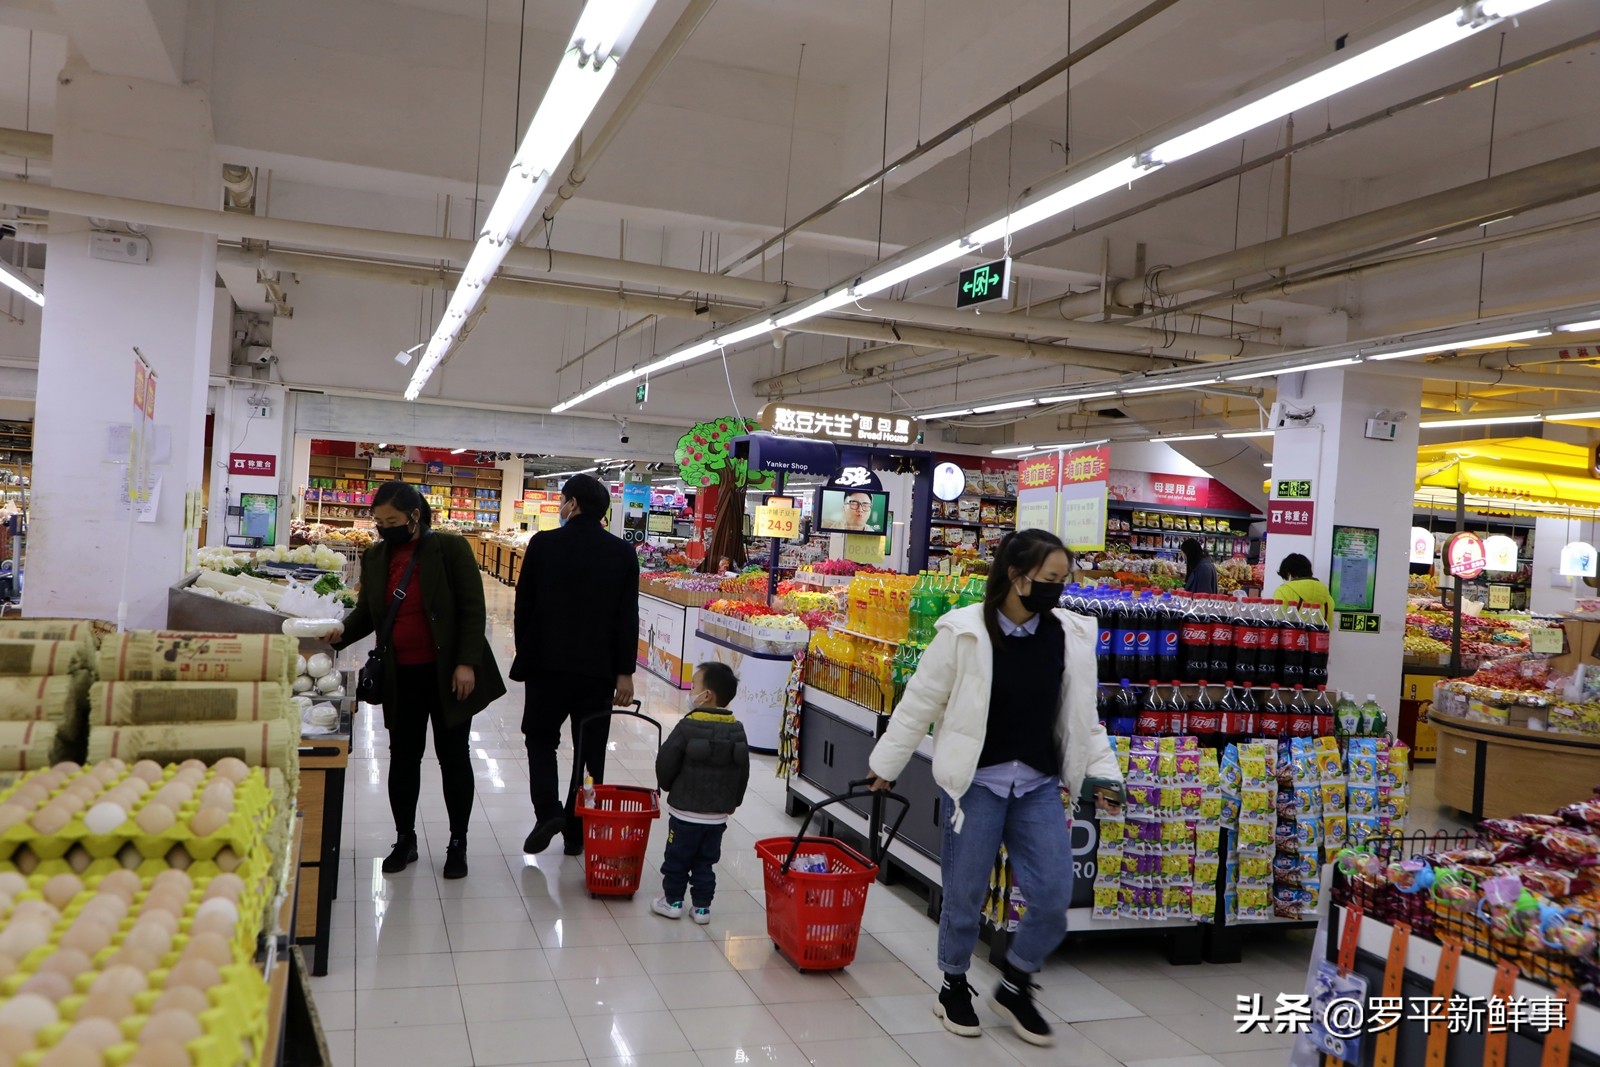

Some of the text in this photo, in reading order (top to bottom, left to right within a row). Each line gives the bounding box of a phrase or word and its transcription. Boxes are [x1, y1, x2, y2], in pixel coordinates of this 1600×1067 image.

[775, 407, 910, 438] 憨豆先生 面包屋
[858, 429, 909, 444] Bread House
[766, 460, 809, 471] Yanker Shop
[1067, 459, 1101, 478] 特价商品
[1023, 466, 1053, 483] 特价商品
[1154, 482, 1196, 496] 母婴用品
[1285, 510, 1309, 522] 称重台
[768, 519, 793, 532] 24.9
